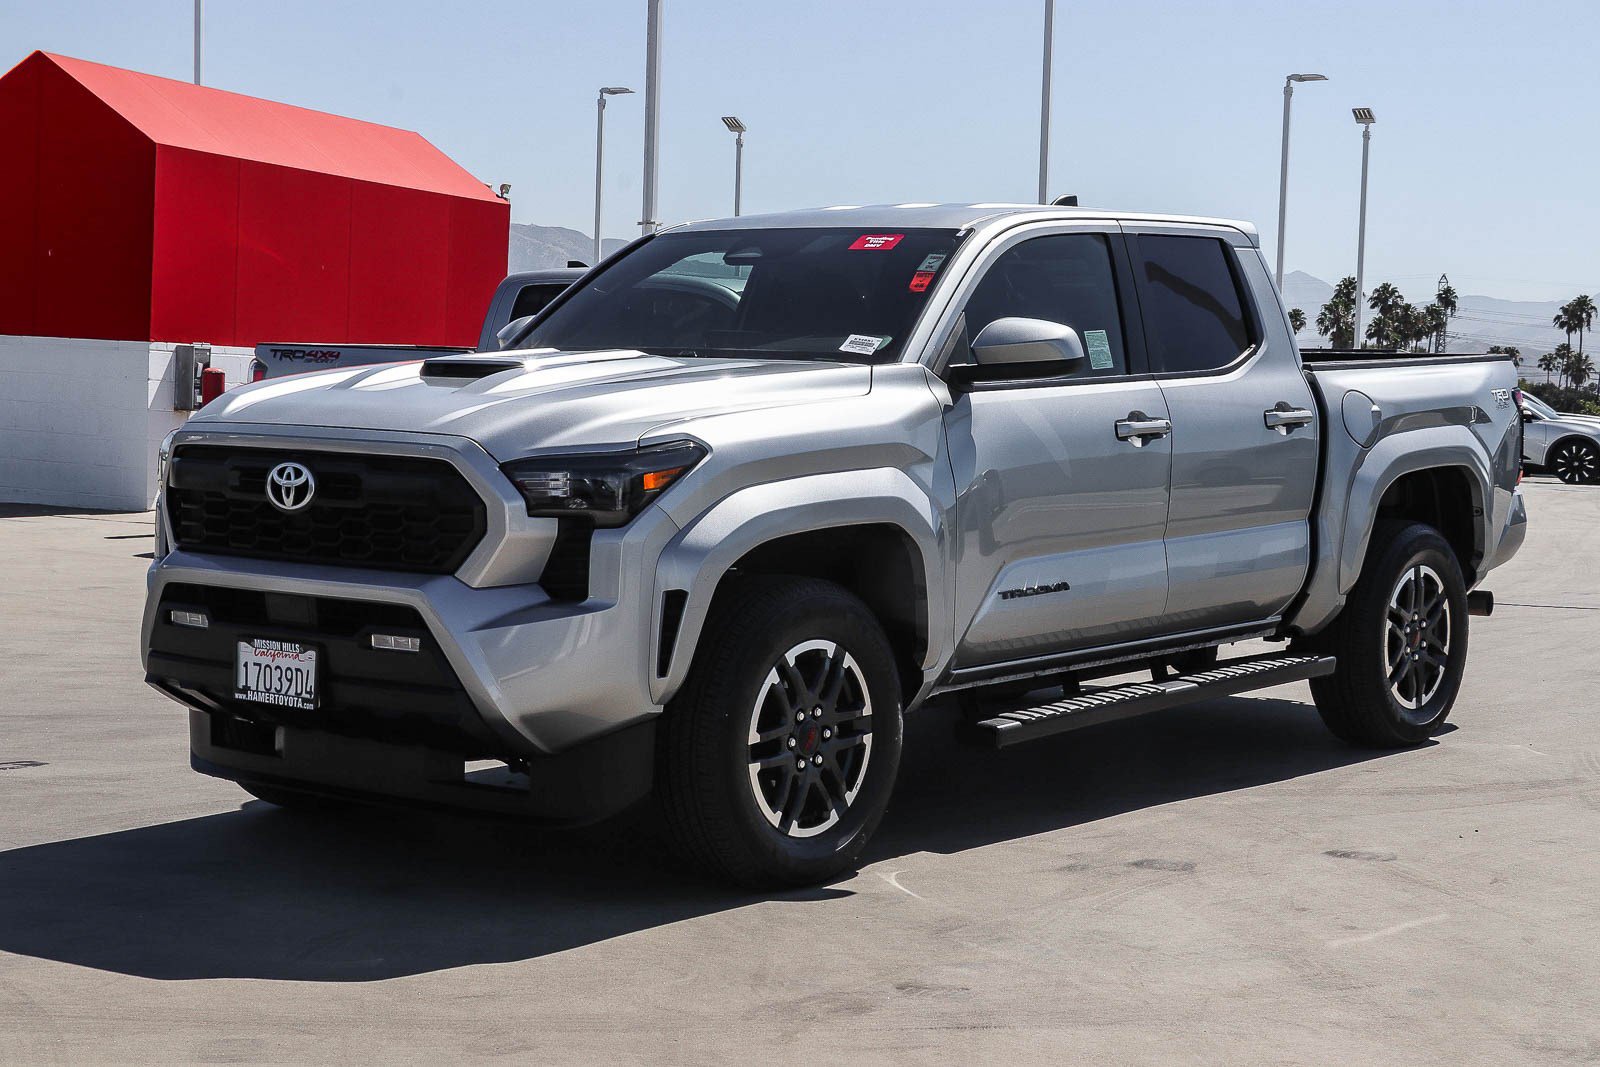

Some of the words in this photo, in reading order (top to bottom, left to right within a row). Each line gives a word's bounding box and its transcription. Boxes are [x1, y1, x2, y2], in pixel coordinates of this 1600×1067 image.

[1491, 388, 1509, 404] TRD
[254, 639, 281, 651] MISSION
[282, 642, 300, 653] HILLS
[254, 648, 305, 663] California
[242, 661, 314, 698] 17039D4
[235, 690, 314, 710] www.HAMERTOYOTA.com
